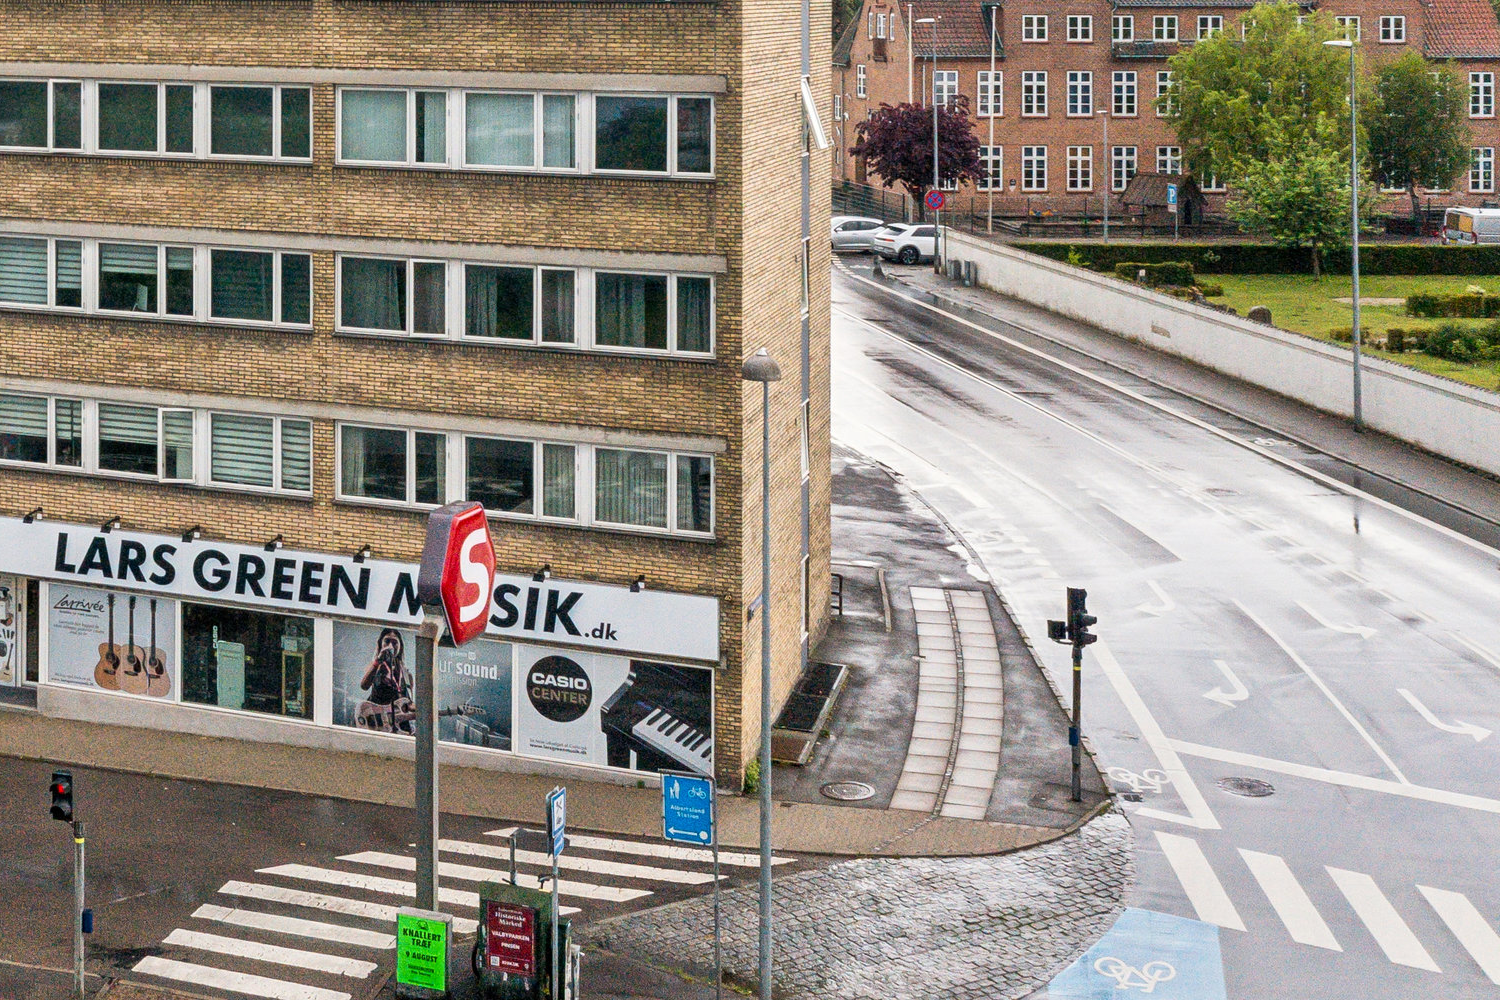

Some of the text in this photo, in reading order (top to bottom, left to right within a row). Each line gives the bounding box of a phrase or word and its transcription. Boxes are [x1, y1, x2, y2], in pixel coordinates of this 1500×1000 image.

[55, 532, 178, 586] LARS
[192, 549, 371, 610] GREEN
[460, 528, 490, 623] S
[53, 594, 105, 613] Larrivée
[455, 662, 501, 681] sound.
[532, 672, 588, 690] CASIO
[532, 687, 587, 705] CENTER
[677, 811, 699, 820] Station
[402, 928, 441, 942] KNALLERT
[411, 938, 432, 949] TRÆF
[412, 952, 438, 963] AUGUST
